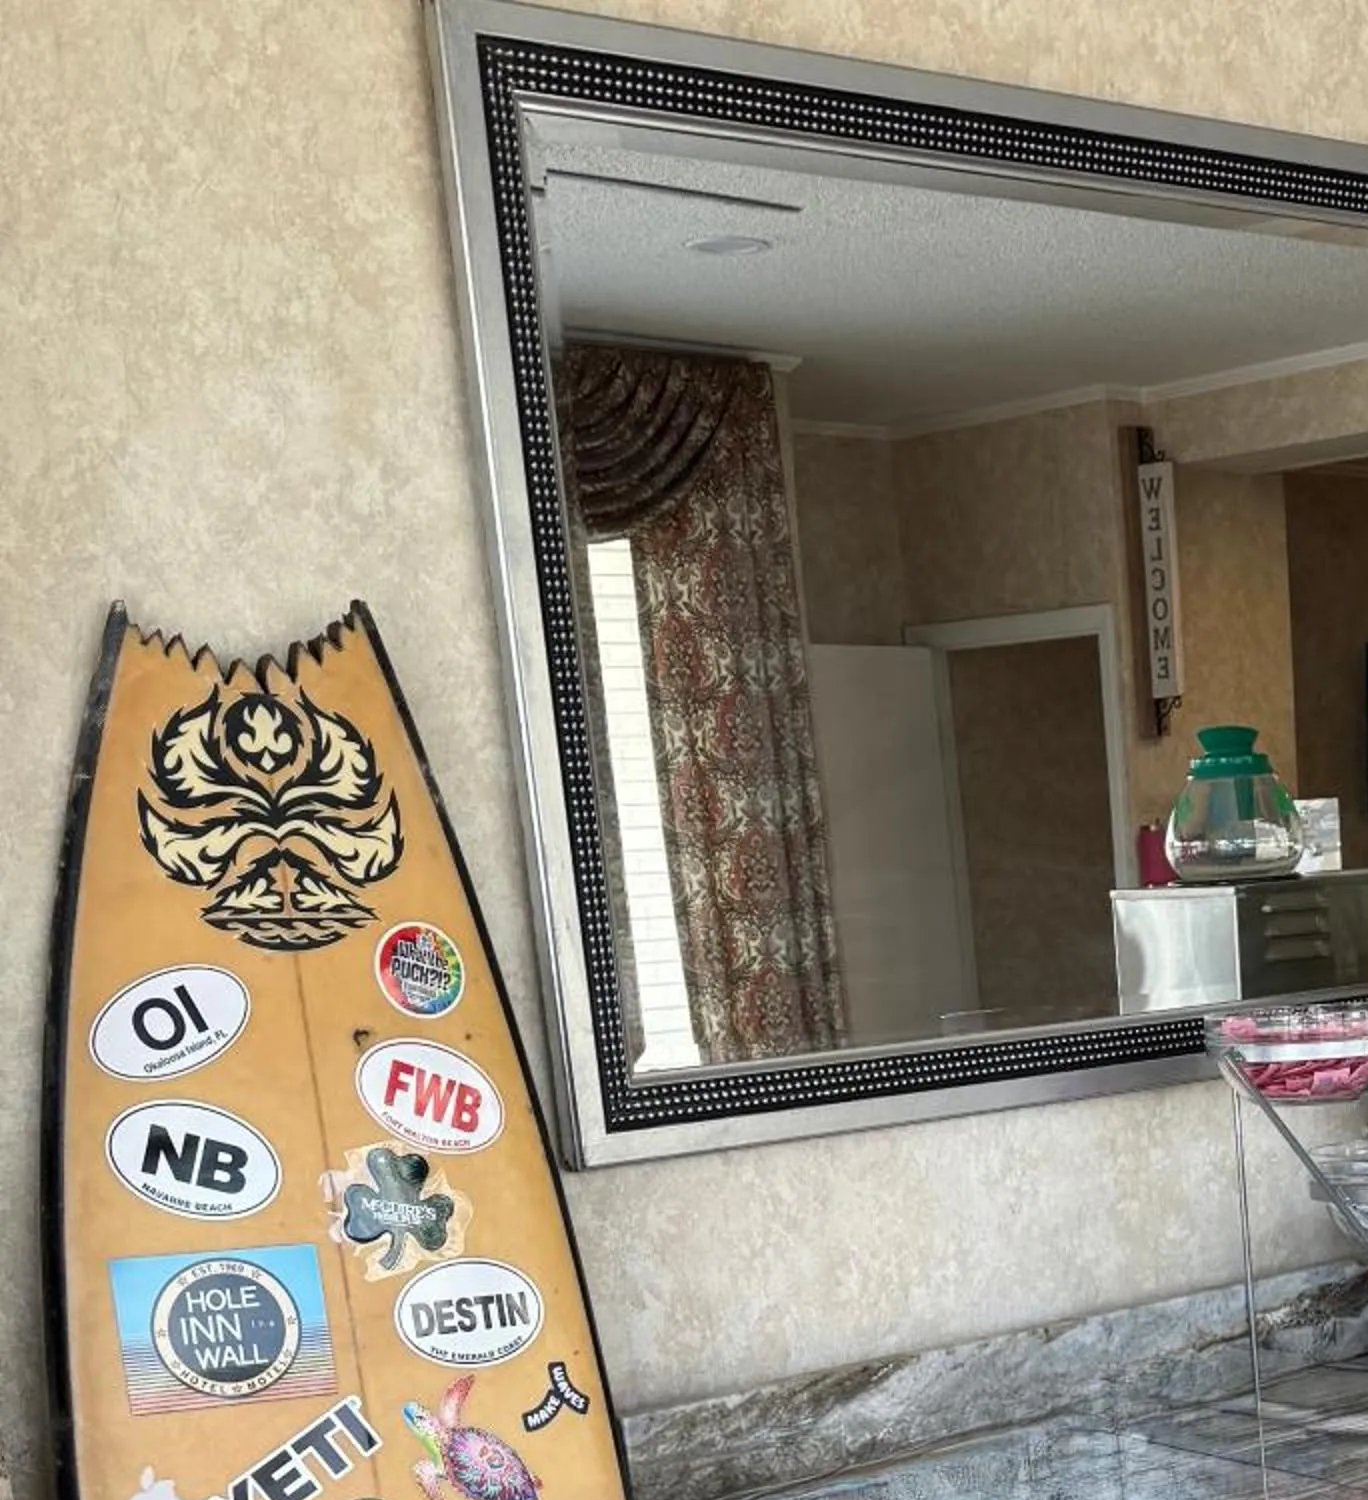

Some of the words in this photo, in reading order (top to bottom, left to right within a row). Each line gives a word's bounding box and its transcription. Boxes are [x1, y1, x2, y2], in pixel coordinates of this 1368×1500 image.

[132, 984, 209, 1051] OI
[143, 1049, 187, 1073] Okaloosa
[215, 1030, 229, 1042] FL
[384, 1059, 482, 1133] FWB
[141, 1123, 249, 1194] NB
[141, 1182, 192, 1210] NAVARRE
[194, 1202, 233, 1213] BEACH
[185, 1286, 261, 1313] HOLE
[410, 1291, 530, 1339] DESTIN
[180, 1313, 243, 1345] INN
[195, 1344, 269, 1371] WALL
[526, 1395, 561, 1428] MAKE
[552, 1366, 586, 1409] WAVES
